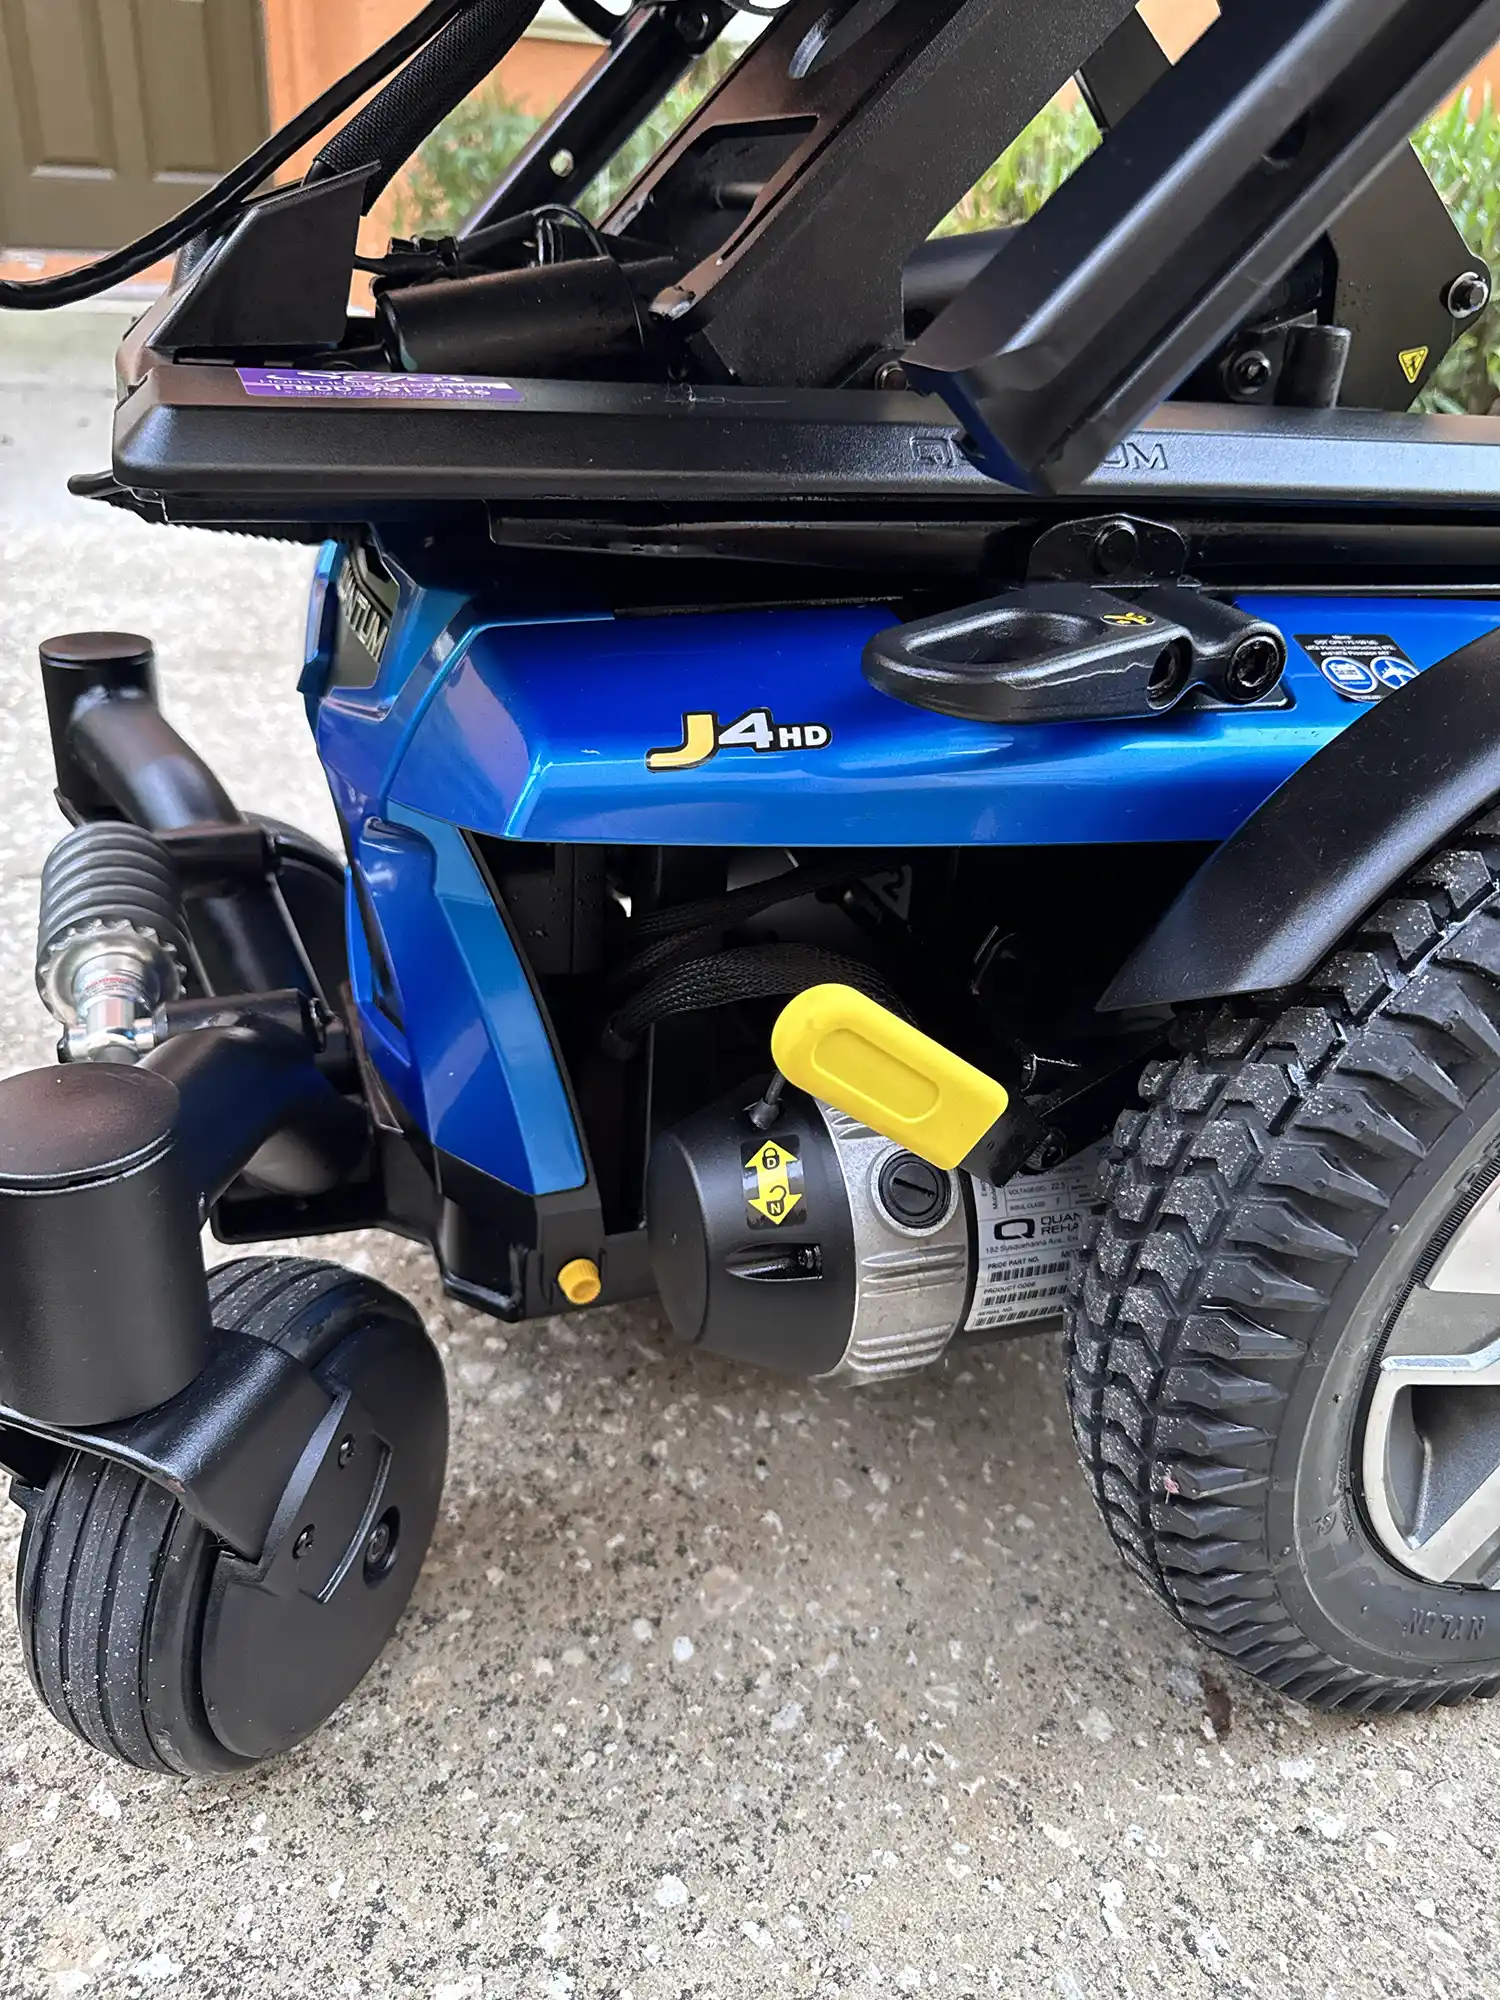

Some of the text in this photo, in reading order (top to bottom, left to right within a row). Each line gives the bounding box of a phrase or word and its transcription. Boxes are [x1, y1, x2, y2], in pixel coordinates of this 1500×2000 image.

[766, 1157, 776, 1168] D
[770, 1202, 781, 1214] N
[1040, 1213, 1080, 1226] QUAN
[1041, 1223, 1079, 1235] REHA
[988, 1261, 1006, 1269] PRIDE
[1008, 1258, 1026, 1267] PART
